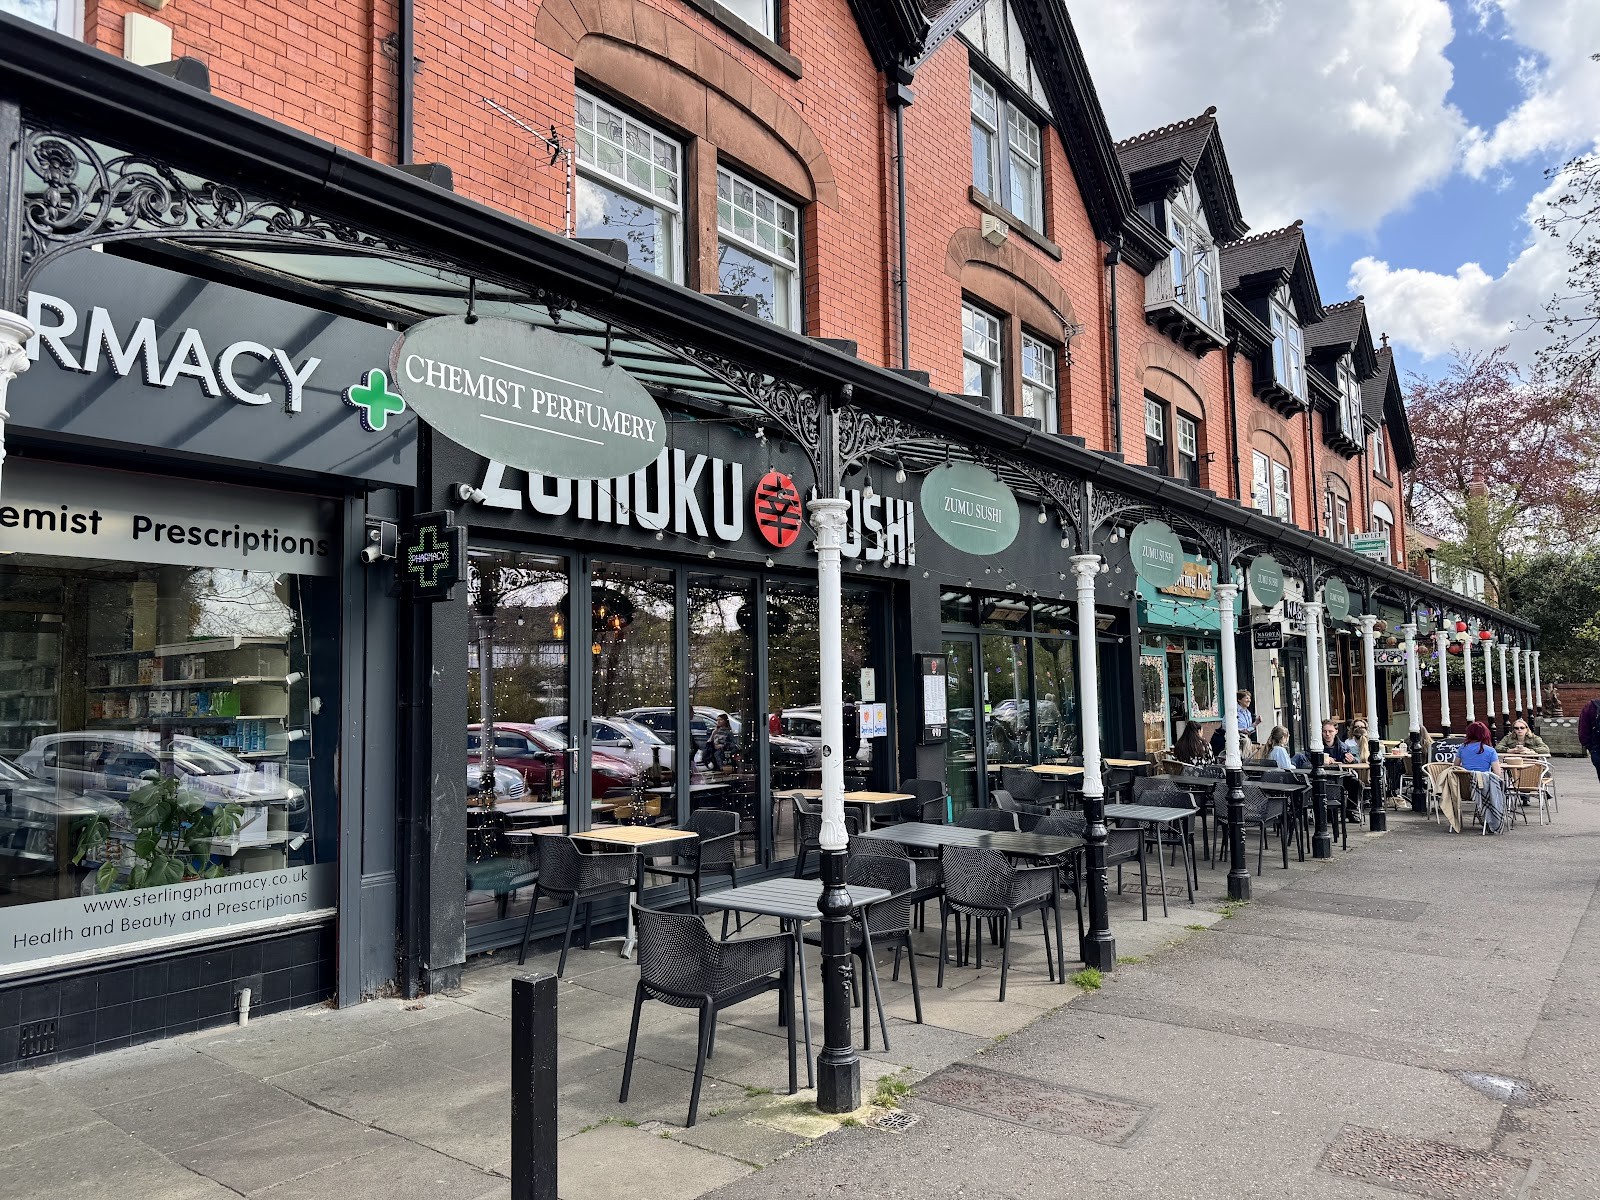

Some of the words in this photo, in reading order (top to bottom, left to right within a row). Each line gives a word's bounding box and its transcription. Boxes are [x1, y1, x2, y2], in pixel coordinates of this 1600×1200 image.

[405, 354, 526, 410] CHEMIST
[531, 387, 657, 443] PERFUMERY
[0, 504, 103, 535] emist
[132, 514, 329, 557] Prescriptions
[811, 484, 916, 567] USHI
[944, 496, 973, 517] ZUMU
[975, 503, 1002, 524] SUSHI
[411, 551, 446, 563] PHARMACY
[1142, 545, 1159, 560] ZUMU
[1160, 549, 1174, 564] SUSHI
[83, 868, 308, 914] www.sterlingpharmacy.co.uk
[13, 926, 74, 949] Health
[81, 919, 114, 938] and
[121, 911, 177, 932] Beauty
[181, 904, 211, 921] and
[217, 891, 308, 916] Prescriptions
